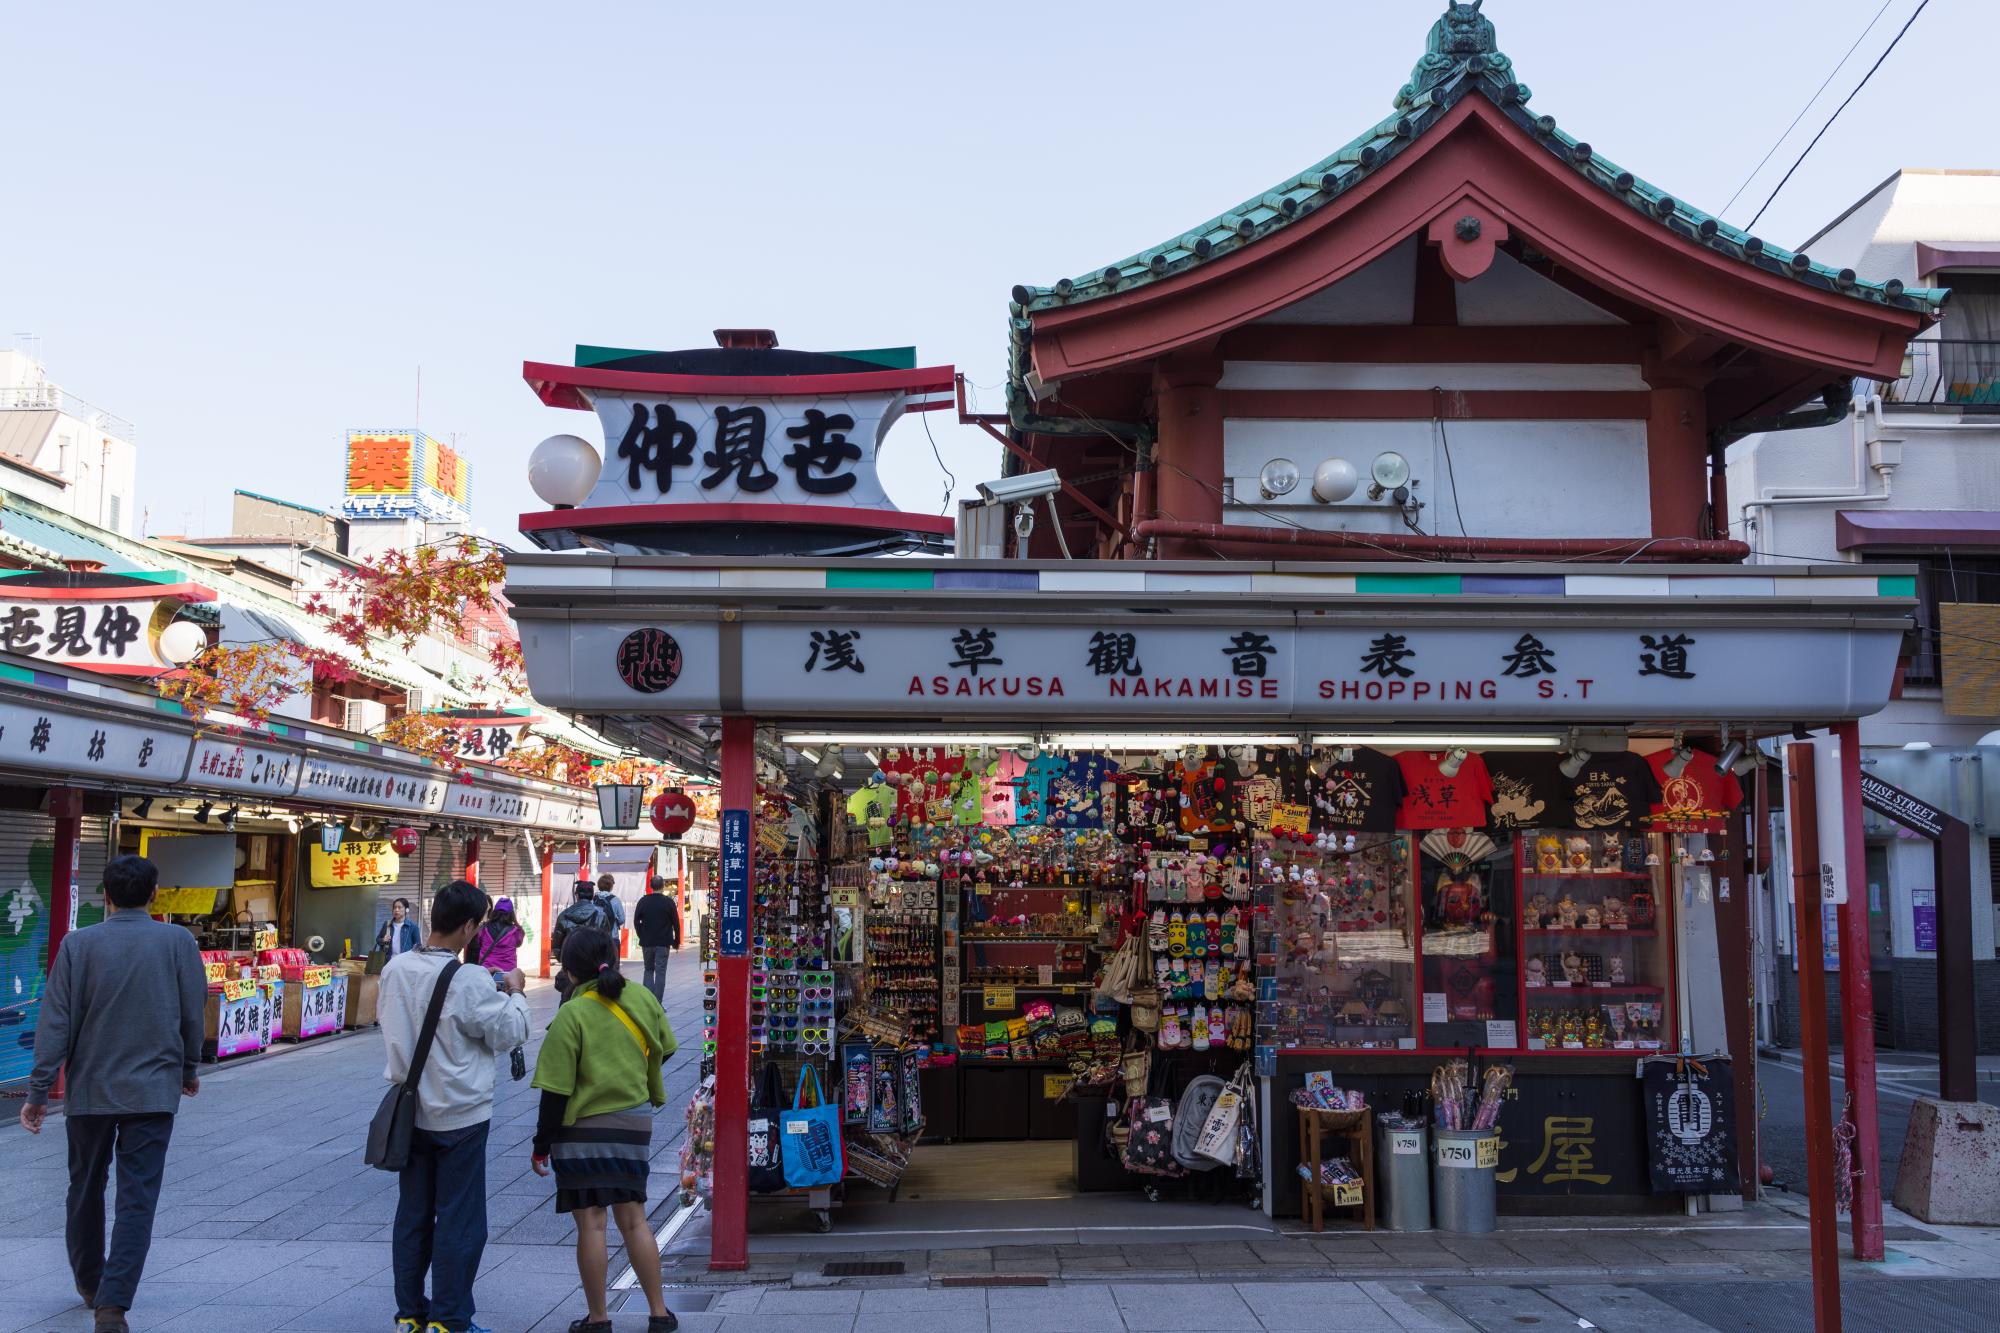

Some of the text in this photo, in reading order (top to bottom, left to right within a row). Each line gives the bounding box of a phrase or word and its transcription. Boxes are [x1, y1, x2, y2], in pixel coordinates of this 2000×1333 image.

[618, 402, 862, 493] 仲見世
[350, 438, 410, 490] 薬
[437, 443, 457, 496] 薬
[908, 676, 1065, 696] ASAKUSA
[1110, 678, 1279, 698] NAKAMISE
[1318, 679, 1498, 700] SHOPPING
[1589, 772, 1610, 781] 日本
[1411, 784, 1458, 808] 浅草
[1893, 794, 1938, 821] STREET
[729, 842, 742, 918] 浅草一丁目
[725, 929, 743, 945] 18
[304, 989, 335, 1018] 人形焼
[220, 1006, 259, 1038] 人形焼
[1396, 1139, 1417, 1149] ¥750
[1441, 1147, 1471, 1161] ¥750
